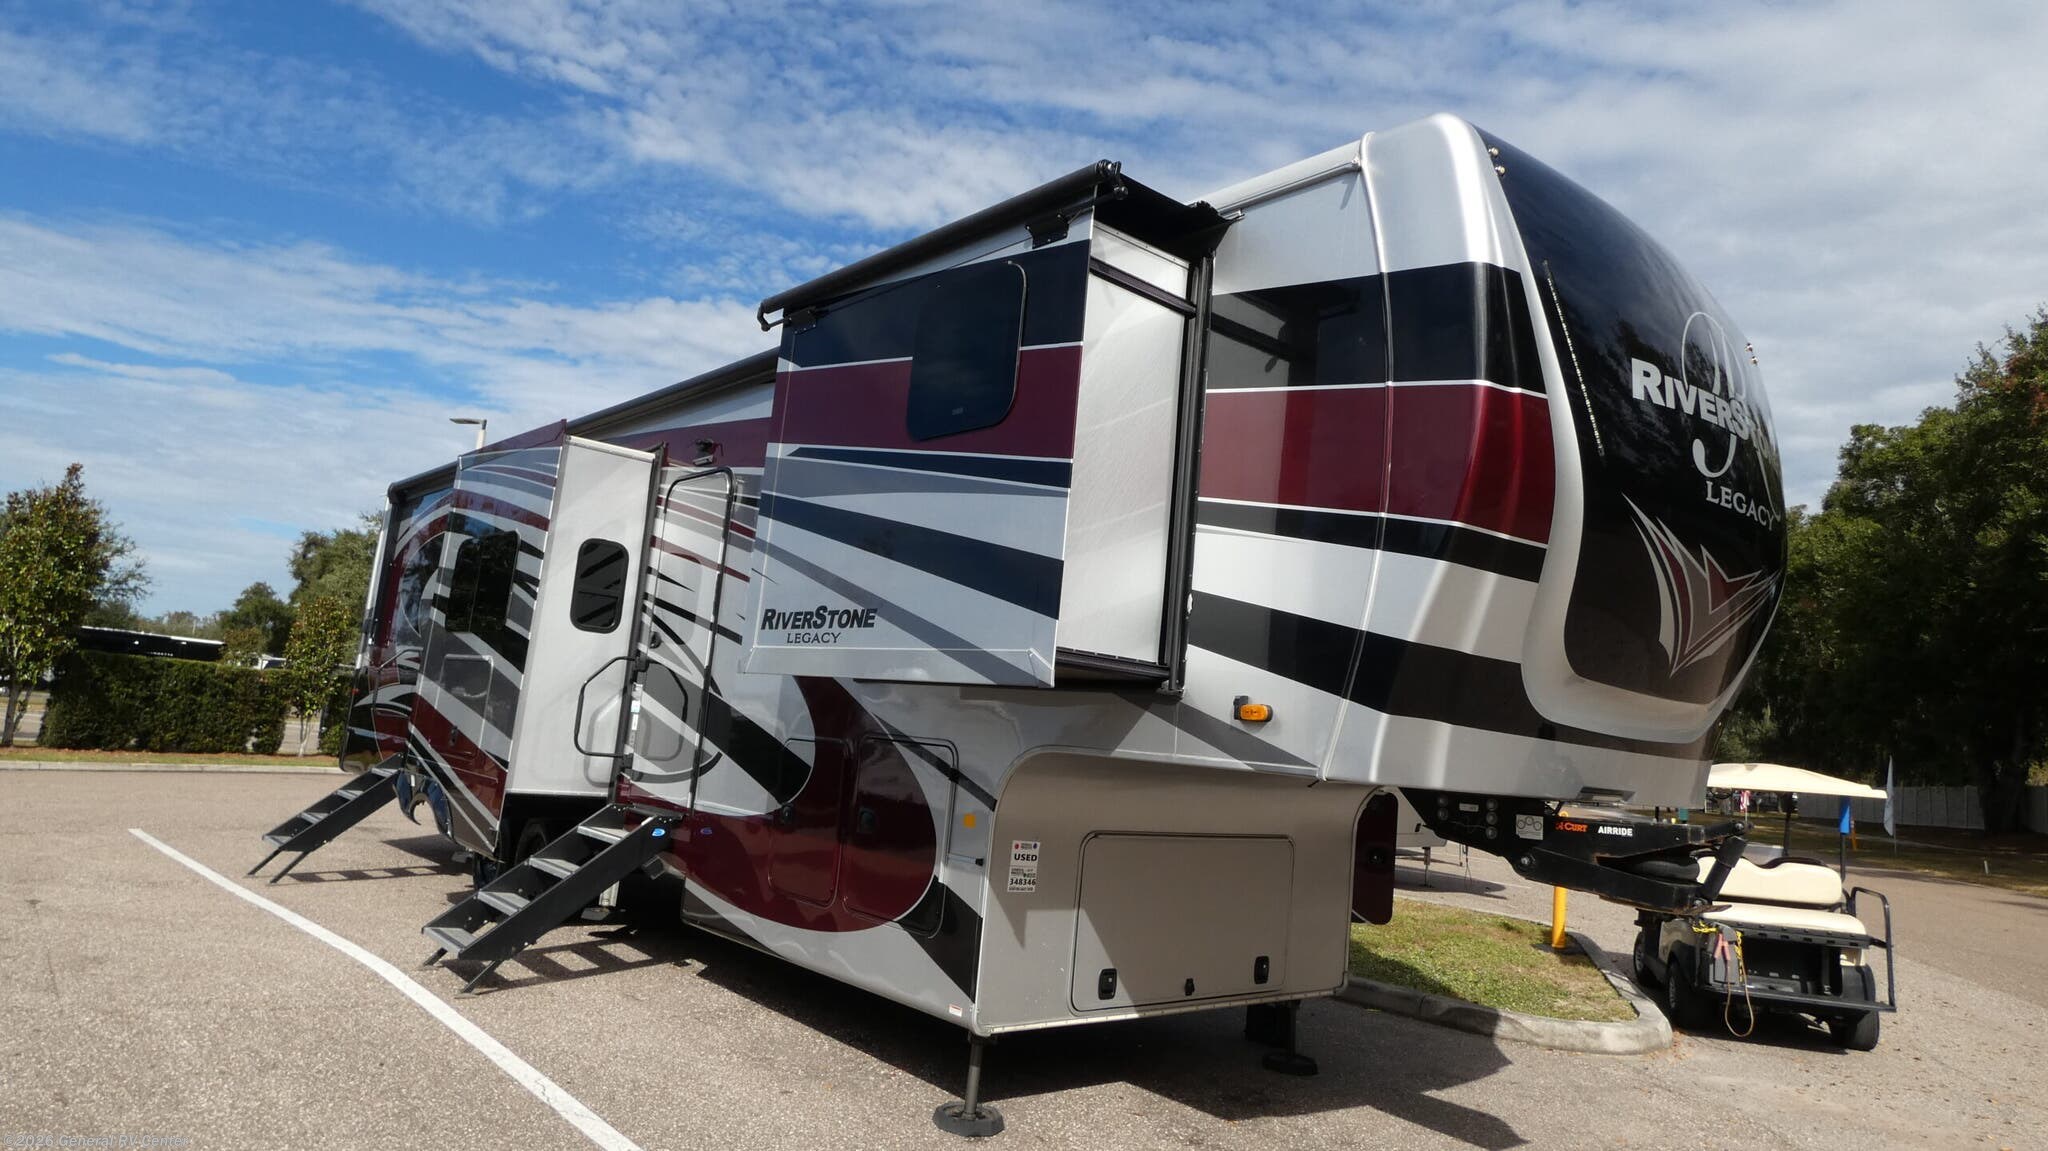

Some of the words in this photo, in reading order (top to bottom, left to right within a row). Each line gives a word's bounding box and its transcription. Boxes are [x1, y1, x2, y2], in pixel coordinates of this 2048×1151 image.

[1631, 357, 1780, 471] RIVERSTO
[1705, 481, 1776, 532] LEGACY
[786, 632, 842, 644] LEGACY
[1564, 822, 1588, 832] CURT
[1598, 826, 1633, 836] AIRRIDE
[1014, 853, 1038, 862] USED
[1009, 878, 1037, 886] 348346
